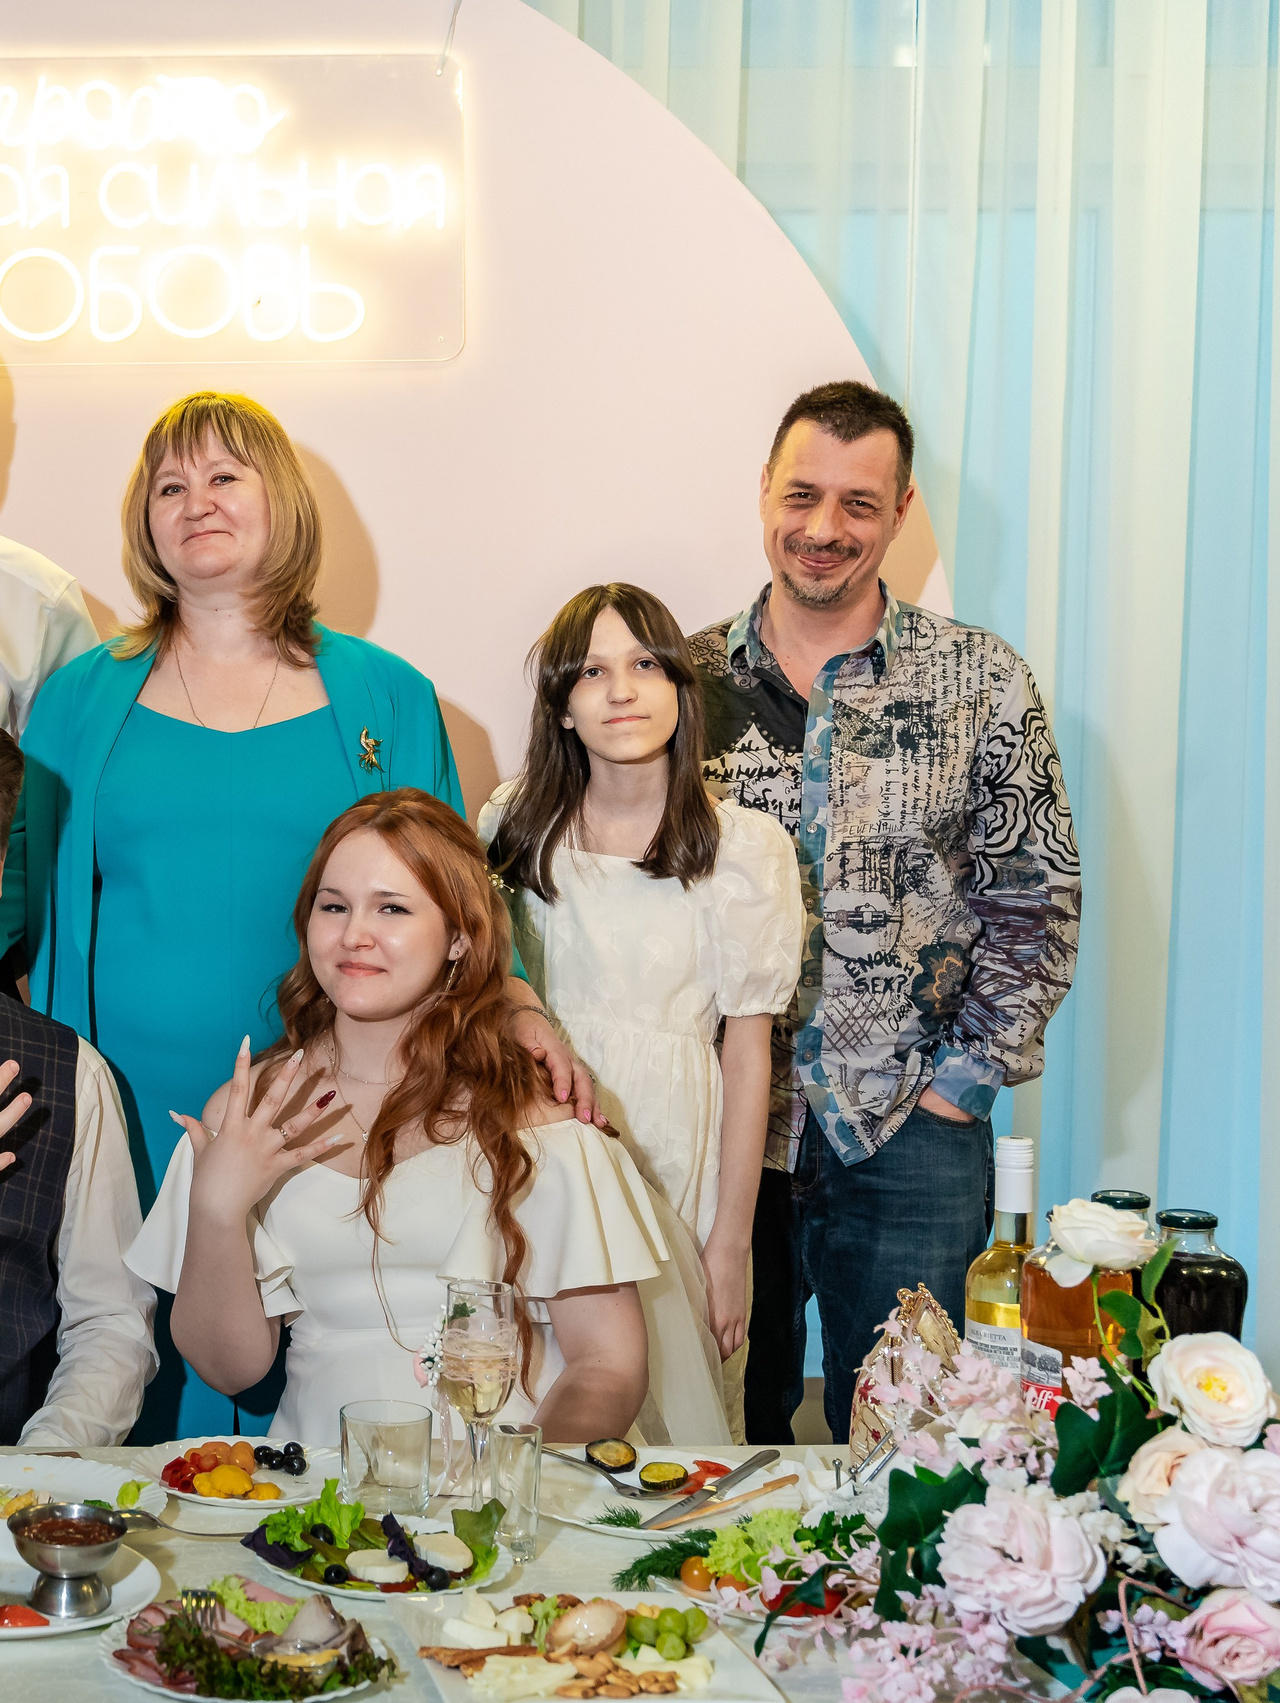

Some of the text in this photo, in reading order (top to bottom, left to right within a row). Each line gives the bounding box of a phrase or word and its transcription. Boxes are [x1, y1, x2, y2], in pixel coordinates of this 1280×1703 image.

[97, 159, 447, 231] сильная
[843, 950, 915, 979] ENOUGH
[852, 973, 908, 995] SEX?
